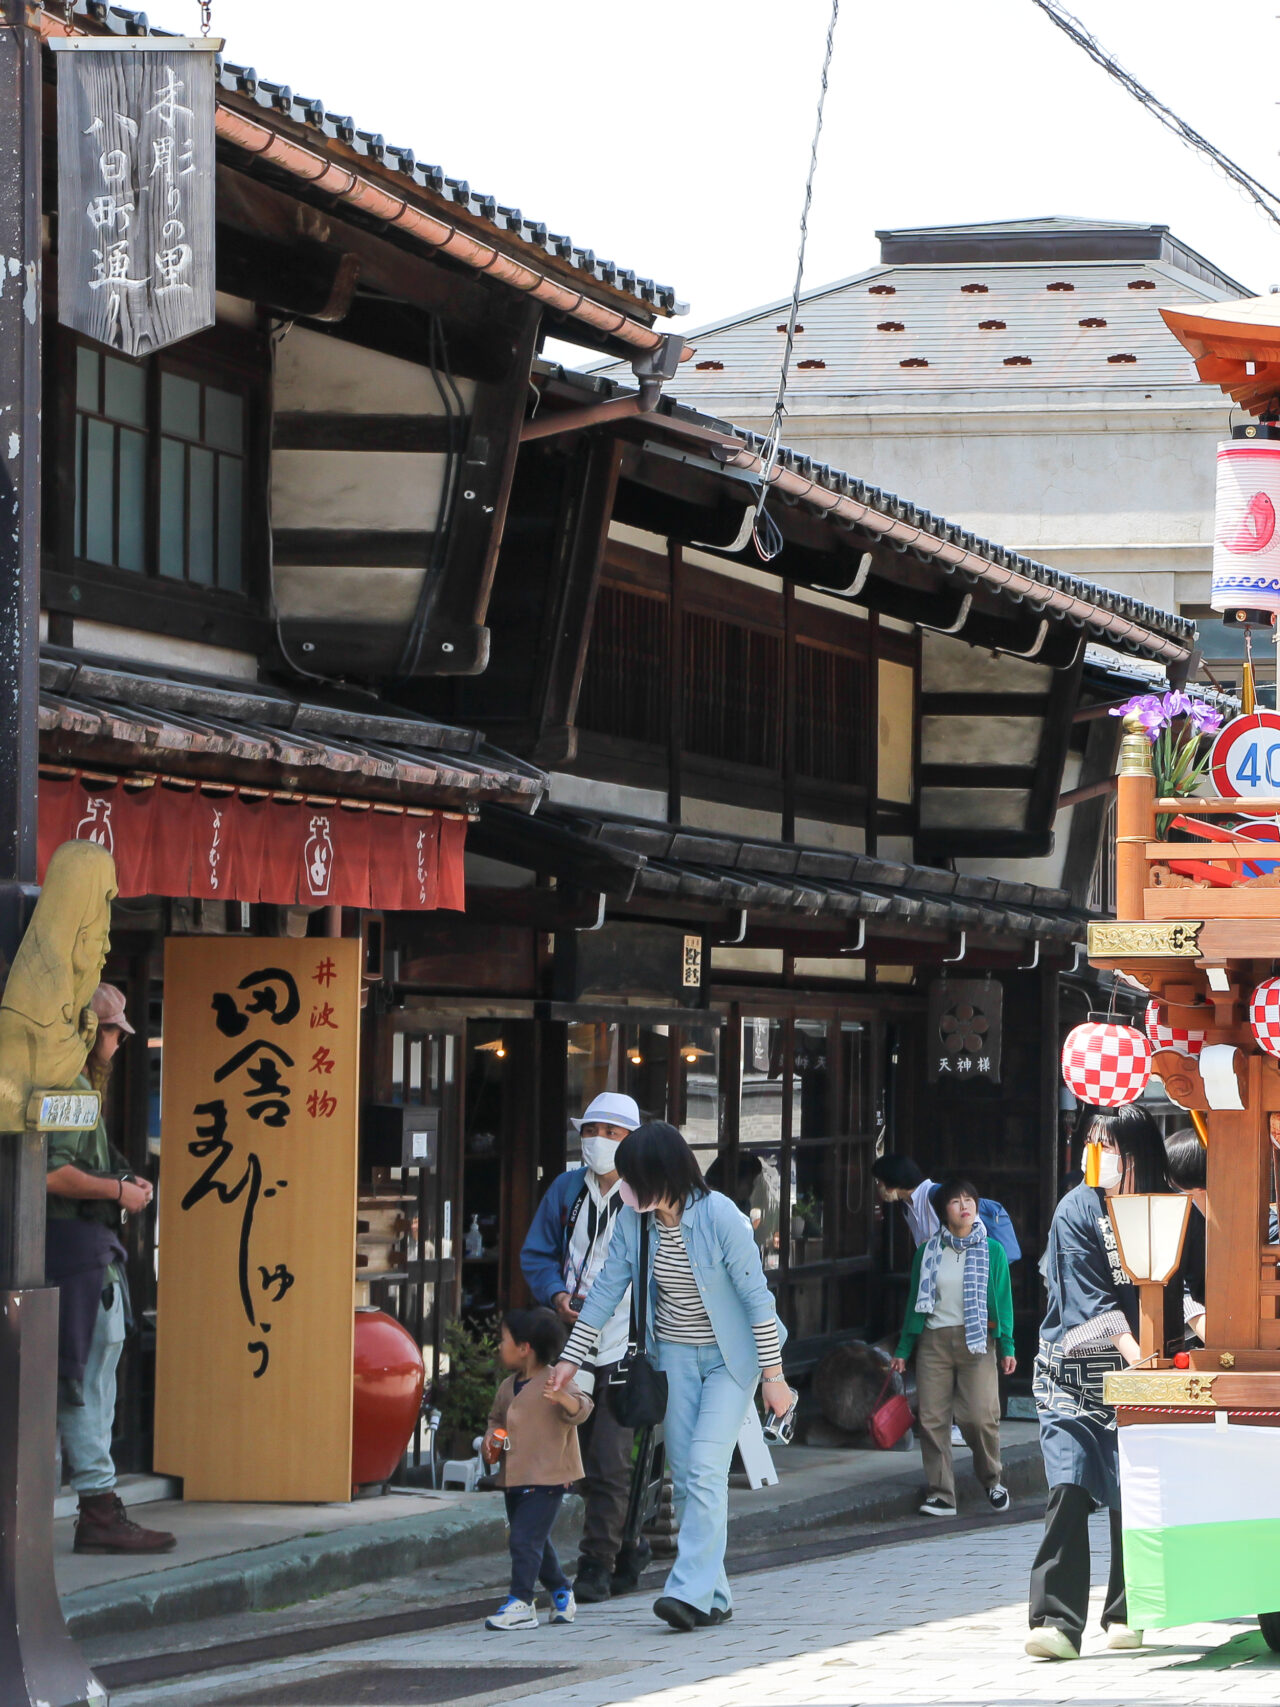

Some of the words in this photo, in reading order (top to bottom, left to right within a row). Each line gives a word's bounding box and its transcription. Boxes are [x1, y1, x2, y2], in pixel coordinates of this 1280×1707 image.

[83, 112, 150, 323] 八日町通り
[146, 66, 195, 295] 木彫りの里
[209, 807, 222, 890] よしむら
[416, 830, 428, 904] よしむら
[306, 956, 339, 1119] 井波名物
[938, 1056, 991, 1073] 天神様
[570, 1197, 583, 1223] SONY
